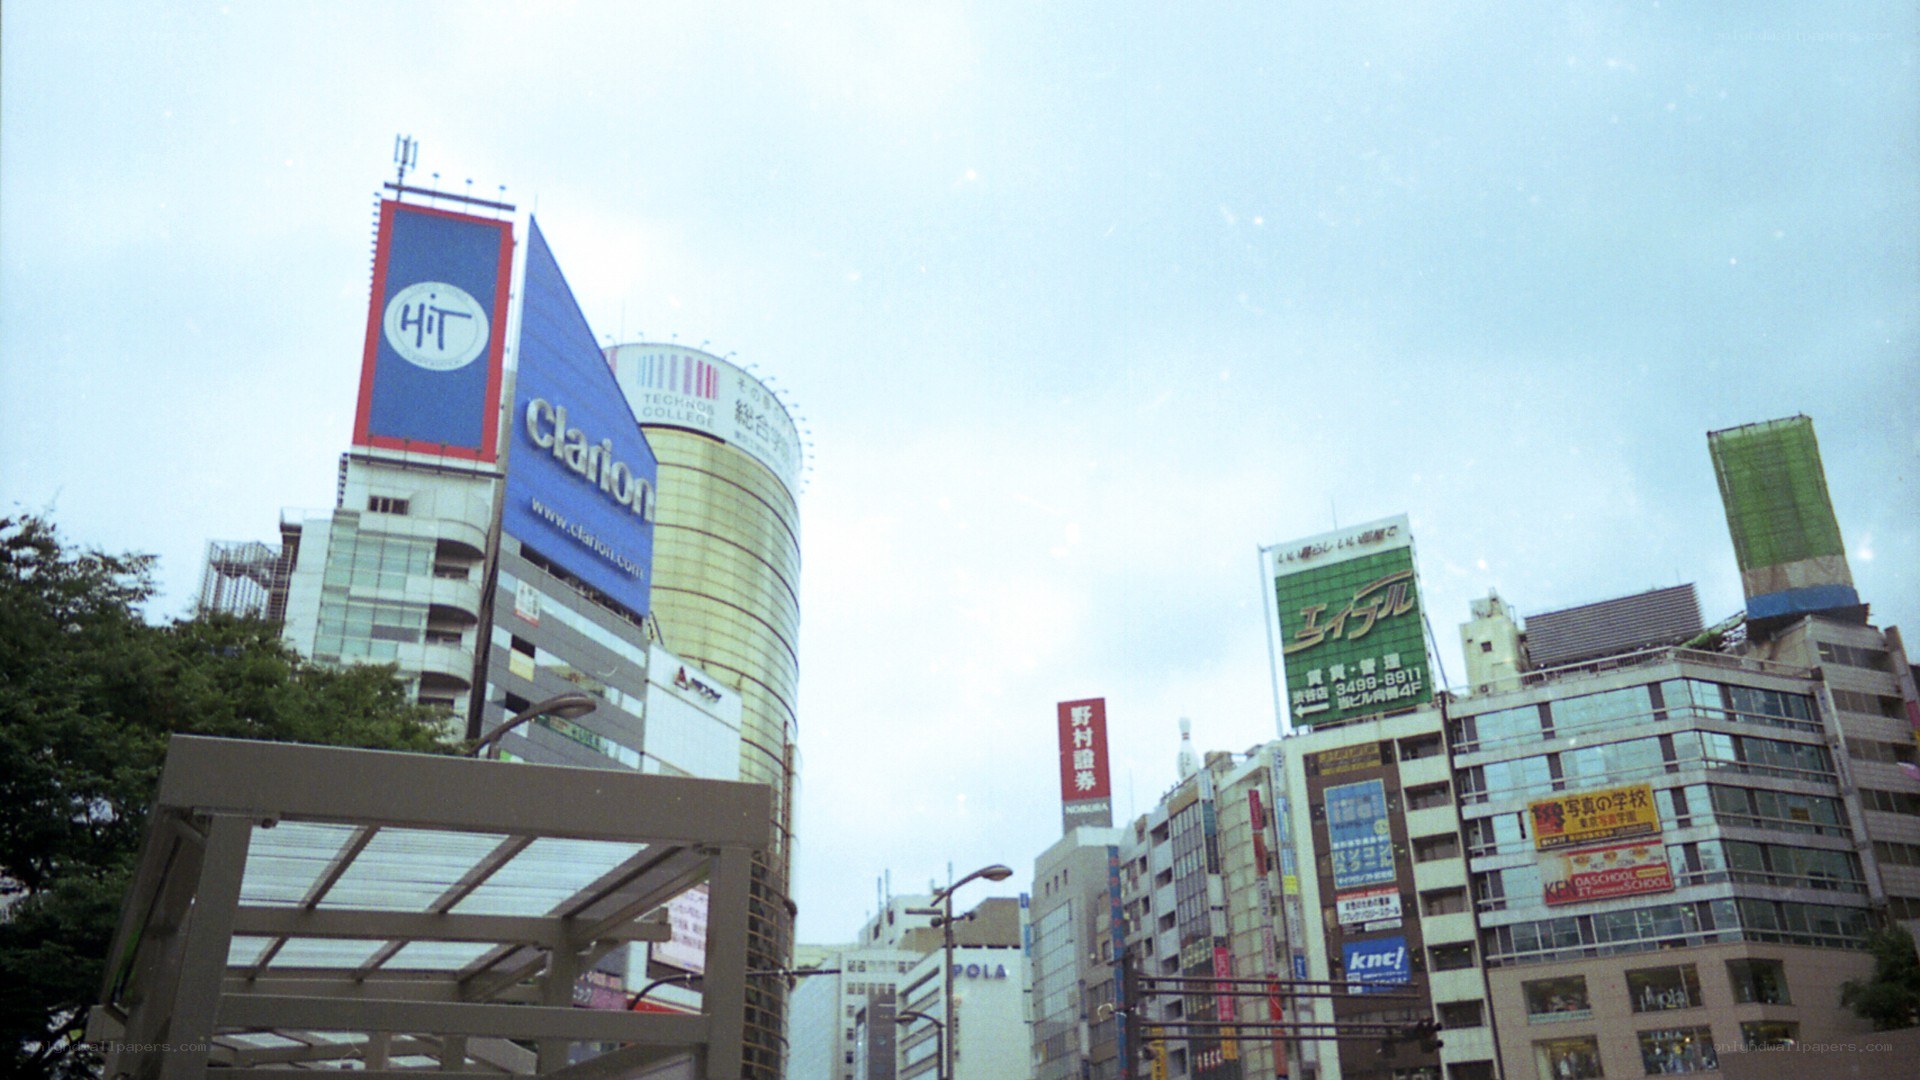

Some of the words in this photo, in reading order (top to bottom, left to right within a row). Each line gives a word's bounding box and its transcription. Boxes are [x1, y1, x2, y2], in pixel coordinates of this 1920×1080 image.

[643, 393, 715, 416] TECHNOS
[643, 407, 715, 428] COLLEGE
[525, 397, 655, 523] Clarion
[531, 495, 645, 580] www.clarion.com
[1283, 568, 1414, 655] エイブル
[1335, 667, 1421, 696] 3499-8911
[1065, 803, 1109, 814] NOMURA
[1565, 789, 1648, 818] 写真の学校
[1335, 844, 1390, 861] パソコン
[1336, 858, 1391, 874] スクール
[1623, 874, 1669, 891] SCHOOL
[952, 964, 1007, 979] POLA
